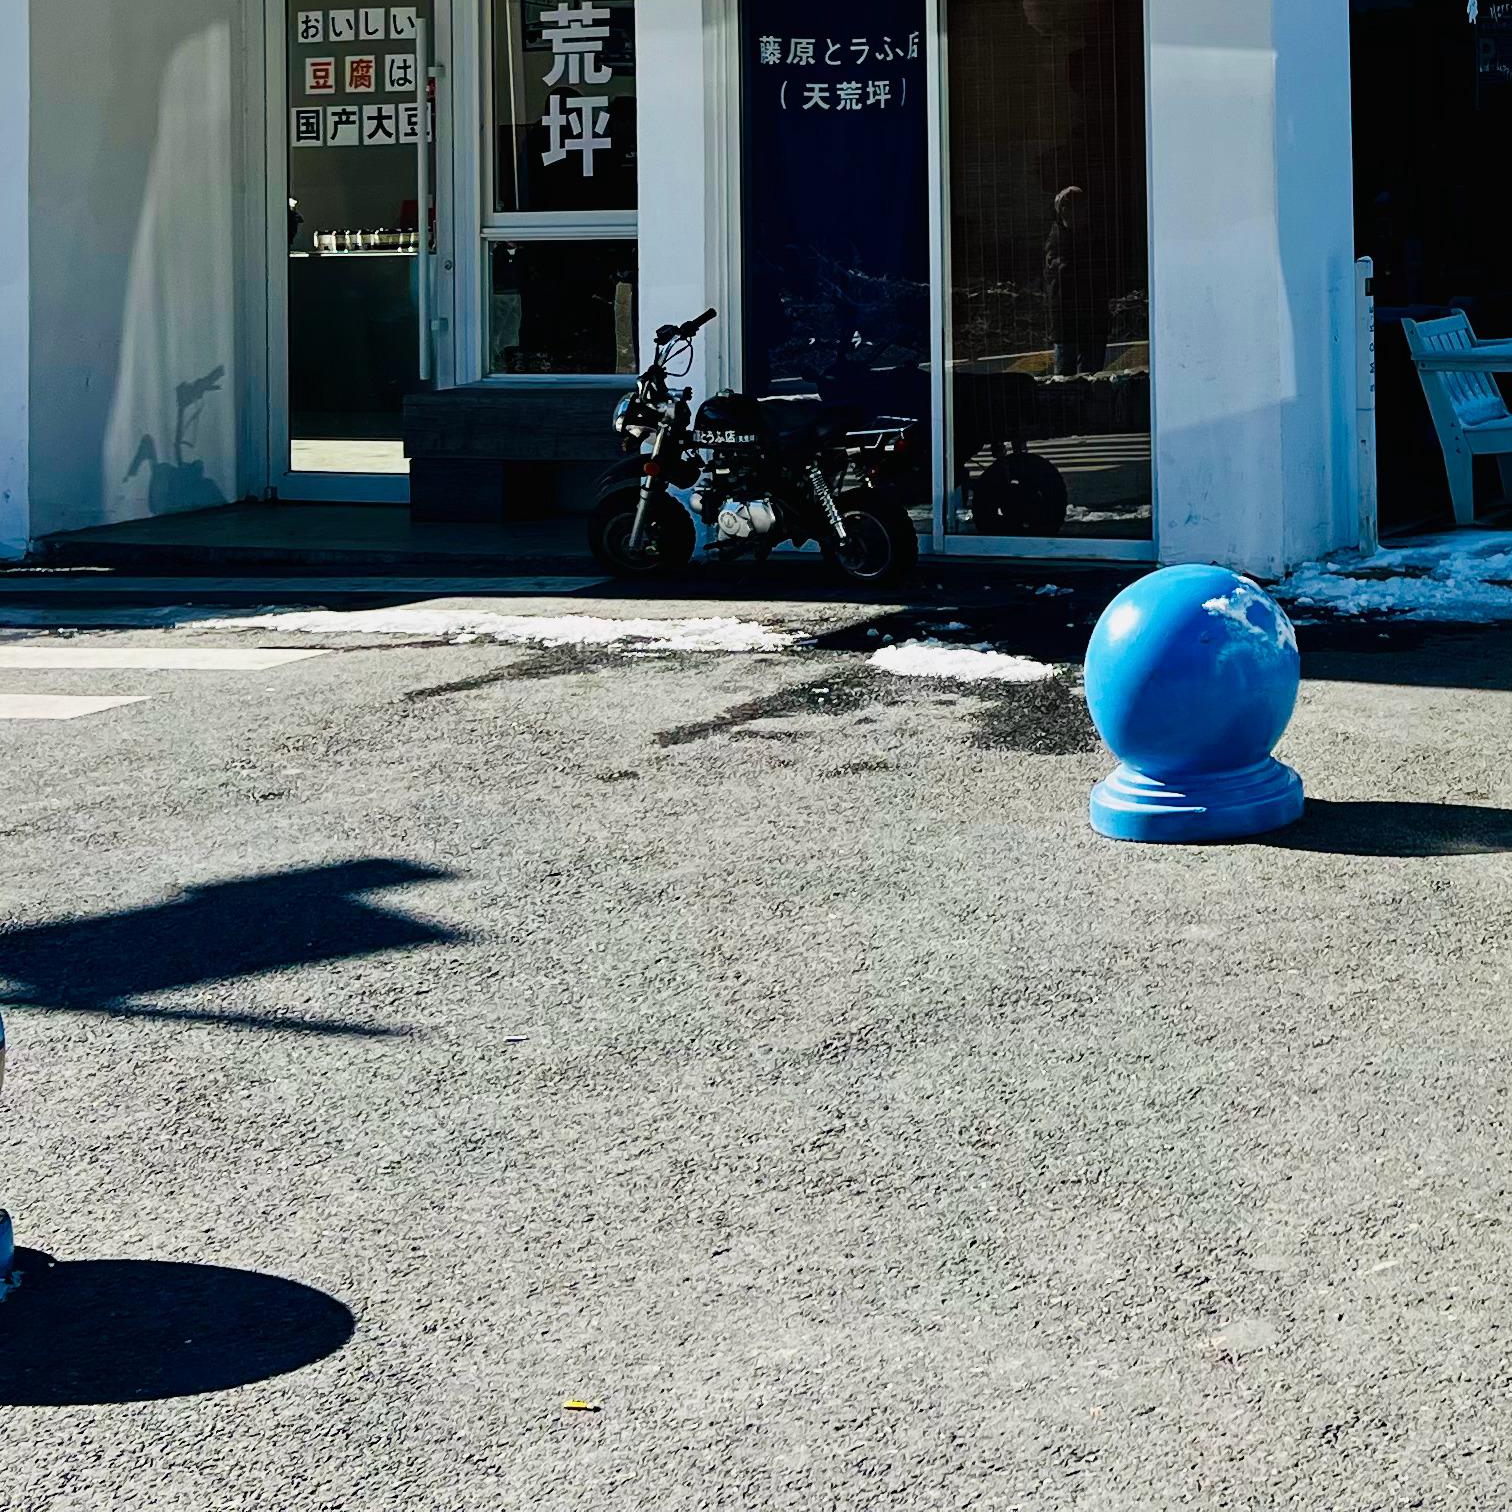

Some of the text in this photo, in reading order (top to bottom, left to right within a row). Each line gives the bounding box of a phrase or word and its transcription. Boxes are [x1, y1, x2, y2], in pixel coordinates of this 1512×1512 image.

[299, 11, 416, 40] おいしい
[308, 57, 415, 92] 豆腐は
